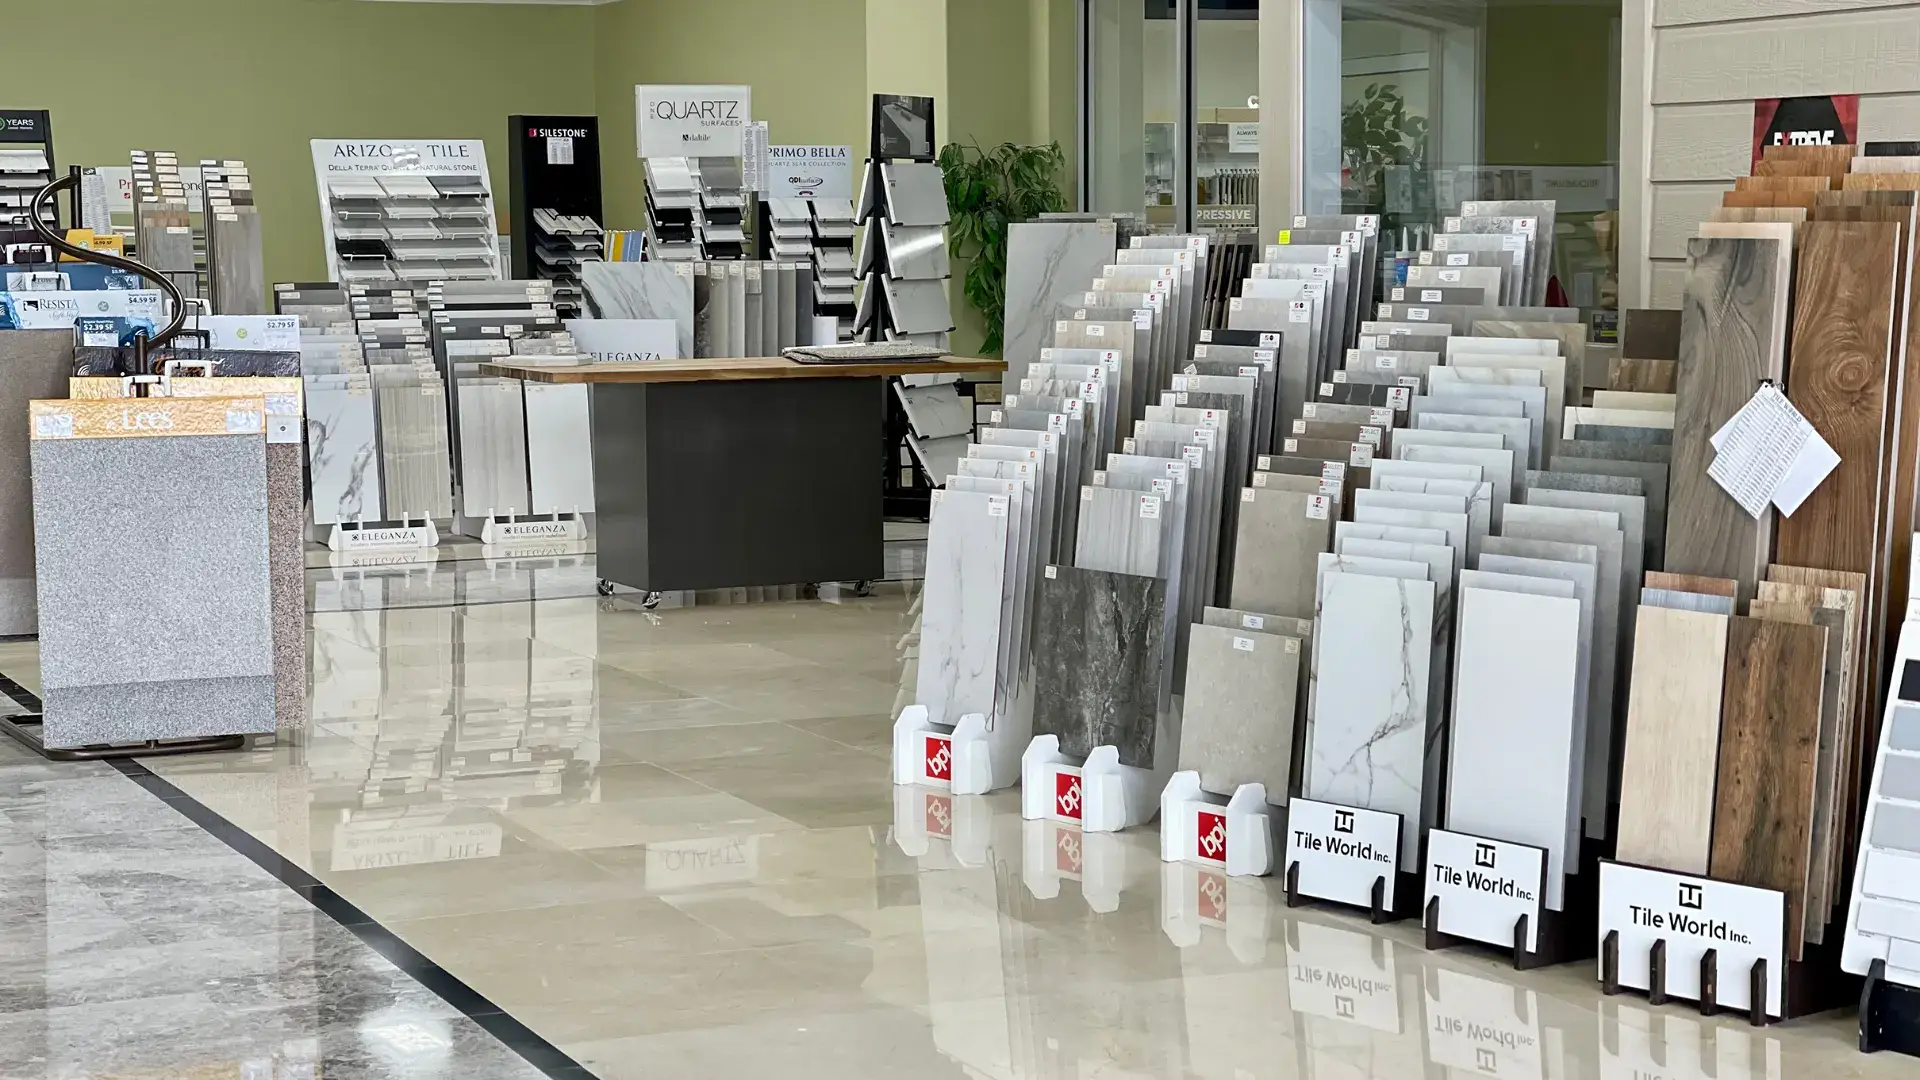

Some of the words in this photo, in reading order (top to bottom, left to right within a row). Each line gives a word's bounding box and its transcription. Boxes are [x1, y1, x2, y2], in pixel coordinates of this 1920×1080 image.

[657, 101, 738, 120] QUARTZ
[539, 129, 586, 138] SILESTONE
[427, 144, 470, 158] TILE
[768, 147, 806, 158] PRIMO
[811, 147, 845, 158] BELLA
[1197, 209, 1252, 220] PRESSIVE
[148, 296, 157, 304] SF
[83, 323, 105, 331] $2.39
[105, 323, 114, 331] SF
[361, 531, 416, 541] ELEGANZA
[514, 525, 566, 534] ELEGANZA
[927, 740, 951, 776] bpi
[1058, 777, 1082, 815] bpi
[1200, 816, 1226, 857] bpi
[1294, 830, 1322, 851] Tile
[1326, 836, 1372, 861] World
[1374, 849, 1392, 863] Inc.
[1433, 864, 1463, 885] Tile
[1466, 869, 1514, 898] World
[1516, 886, 1535, 901] Inc.
[1629, 904, 1664, 929] Tile
[1669, 911, 1727, 940] World
[1729, 929, 1752, 945] Inc.
